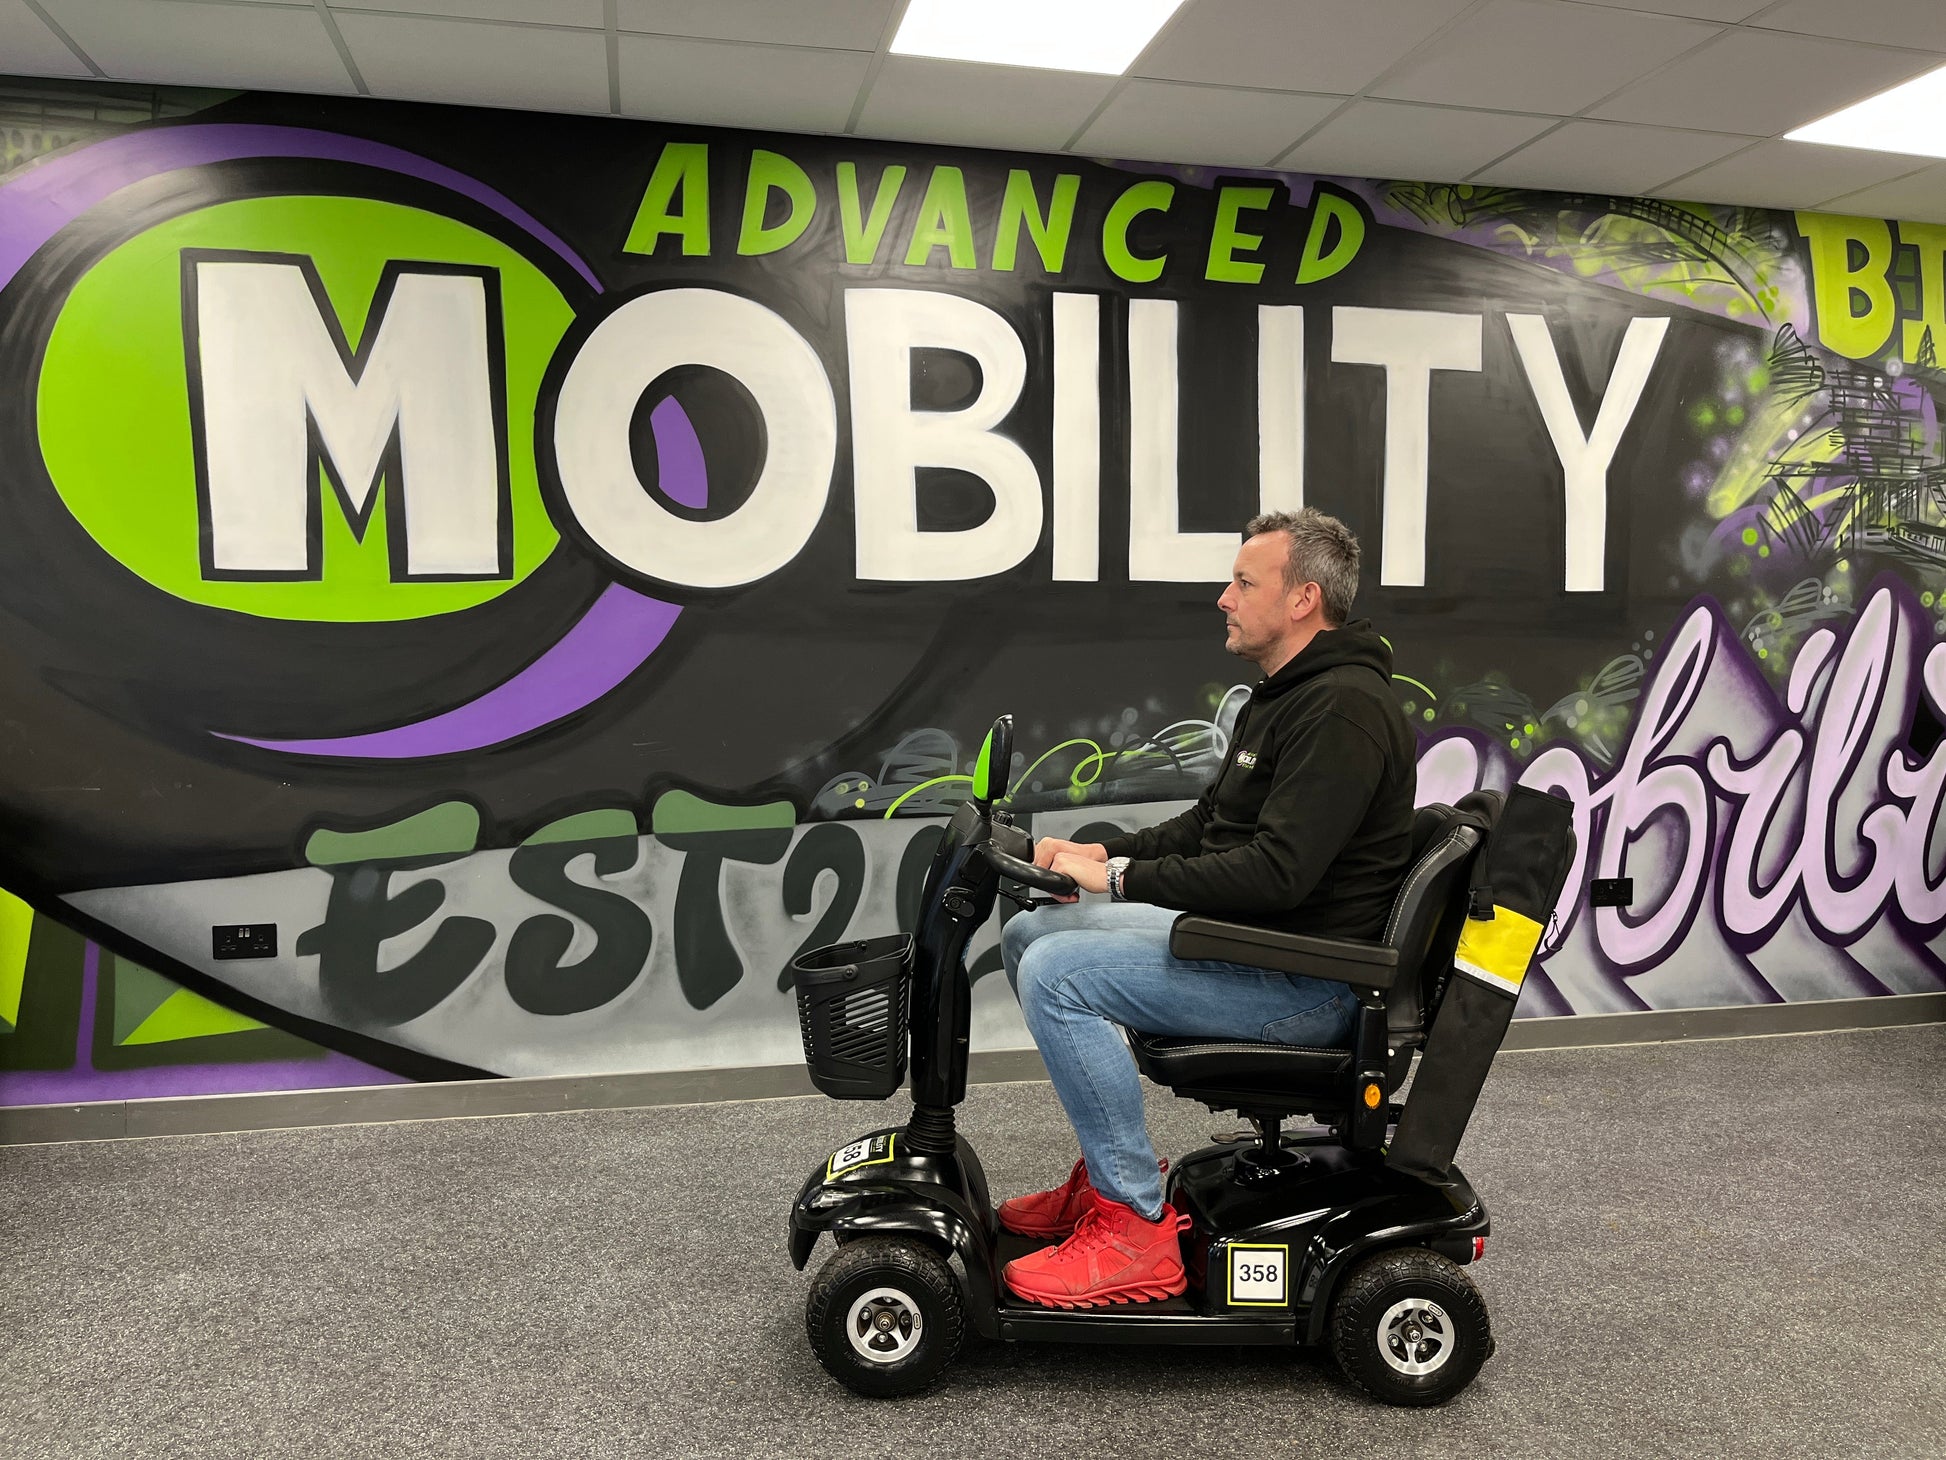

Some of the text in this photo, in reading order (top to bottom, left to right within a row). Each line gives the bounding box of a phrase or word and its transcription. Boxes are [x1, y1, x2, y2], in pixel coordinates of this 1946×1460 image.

[622, 142, 1366, 286] ADVANCED
[196, 261, 1671, 592] MOBILITY
[1239, 1264, 1278, 1282] 358
